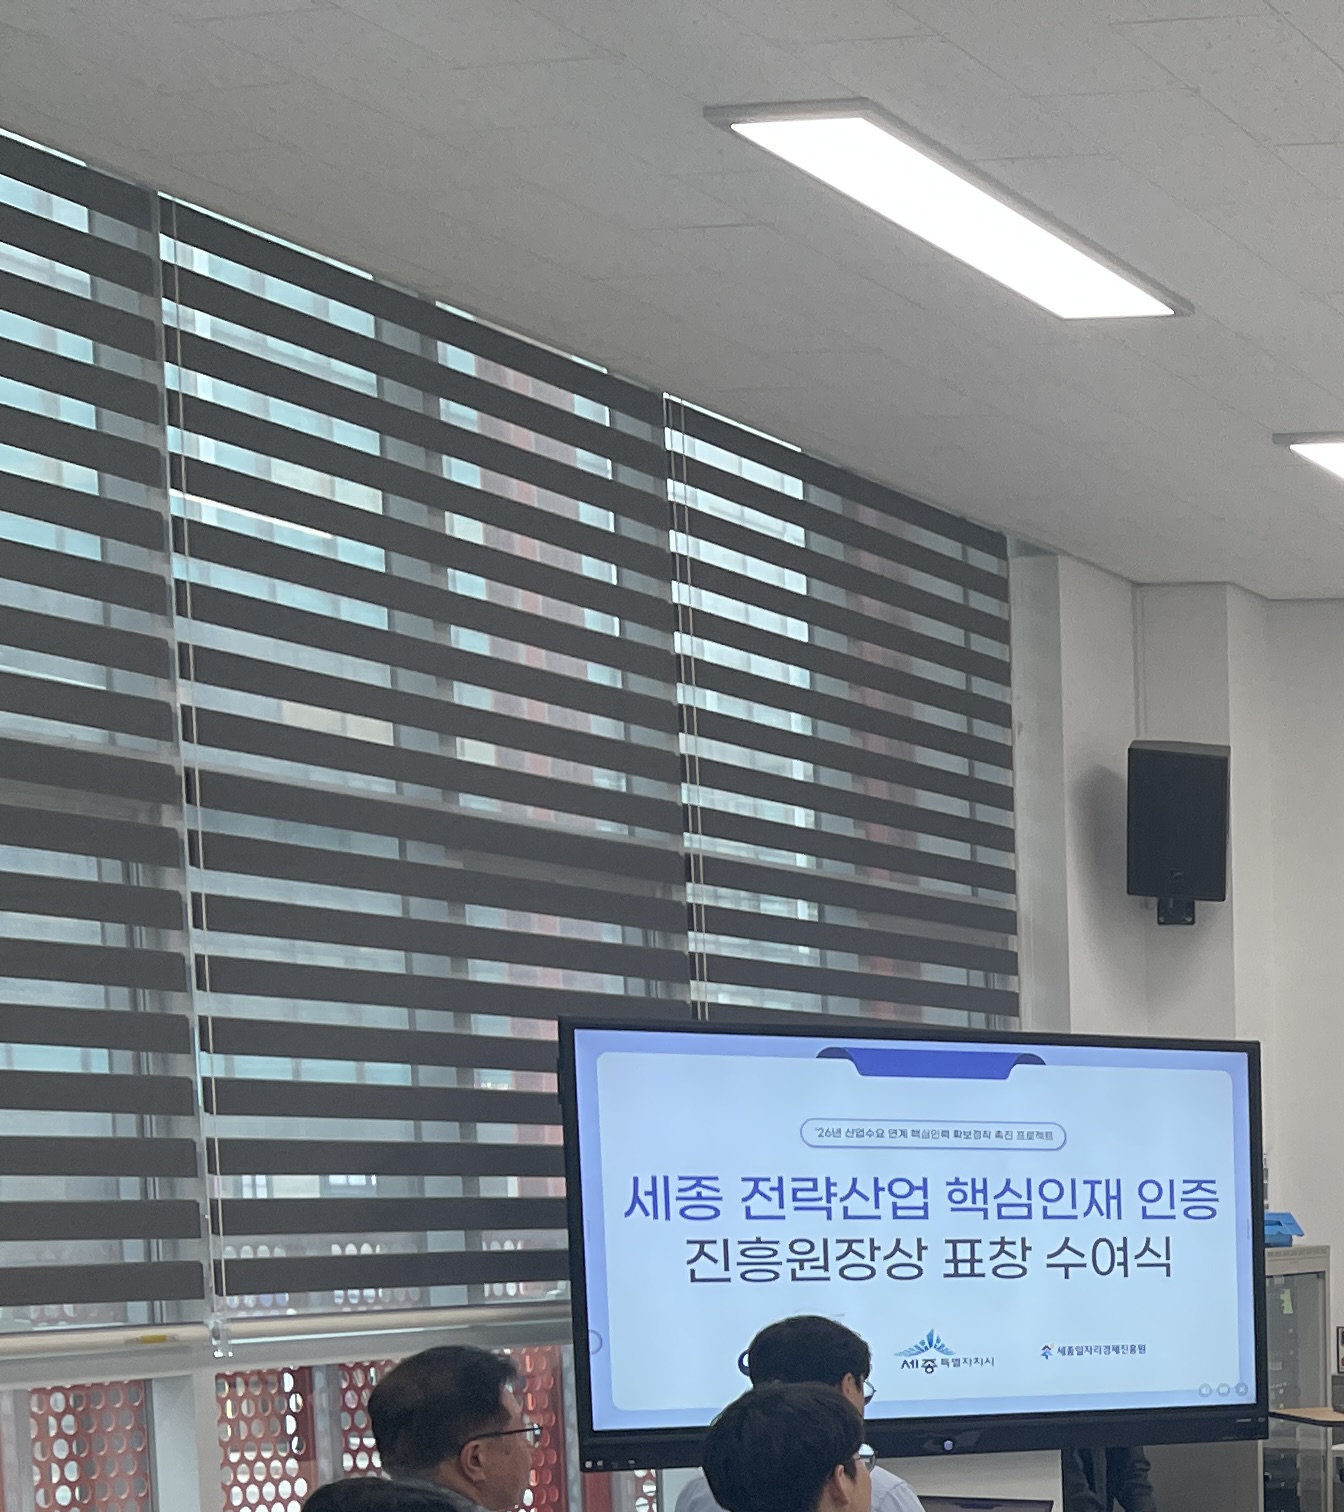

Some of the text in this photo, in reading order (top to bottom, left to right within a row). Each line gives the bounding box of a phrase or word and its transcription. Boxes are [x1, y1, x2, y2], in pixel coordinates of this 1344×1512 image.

[625, 1176, 1219, 1220] 세종 전략산업 핵심인재 인증
[687, 1236, 1170, 1282] 진흥원장상 표창 수여식
[901, 1358, 938, 1374] 세종
